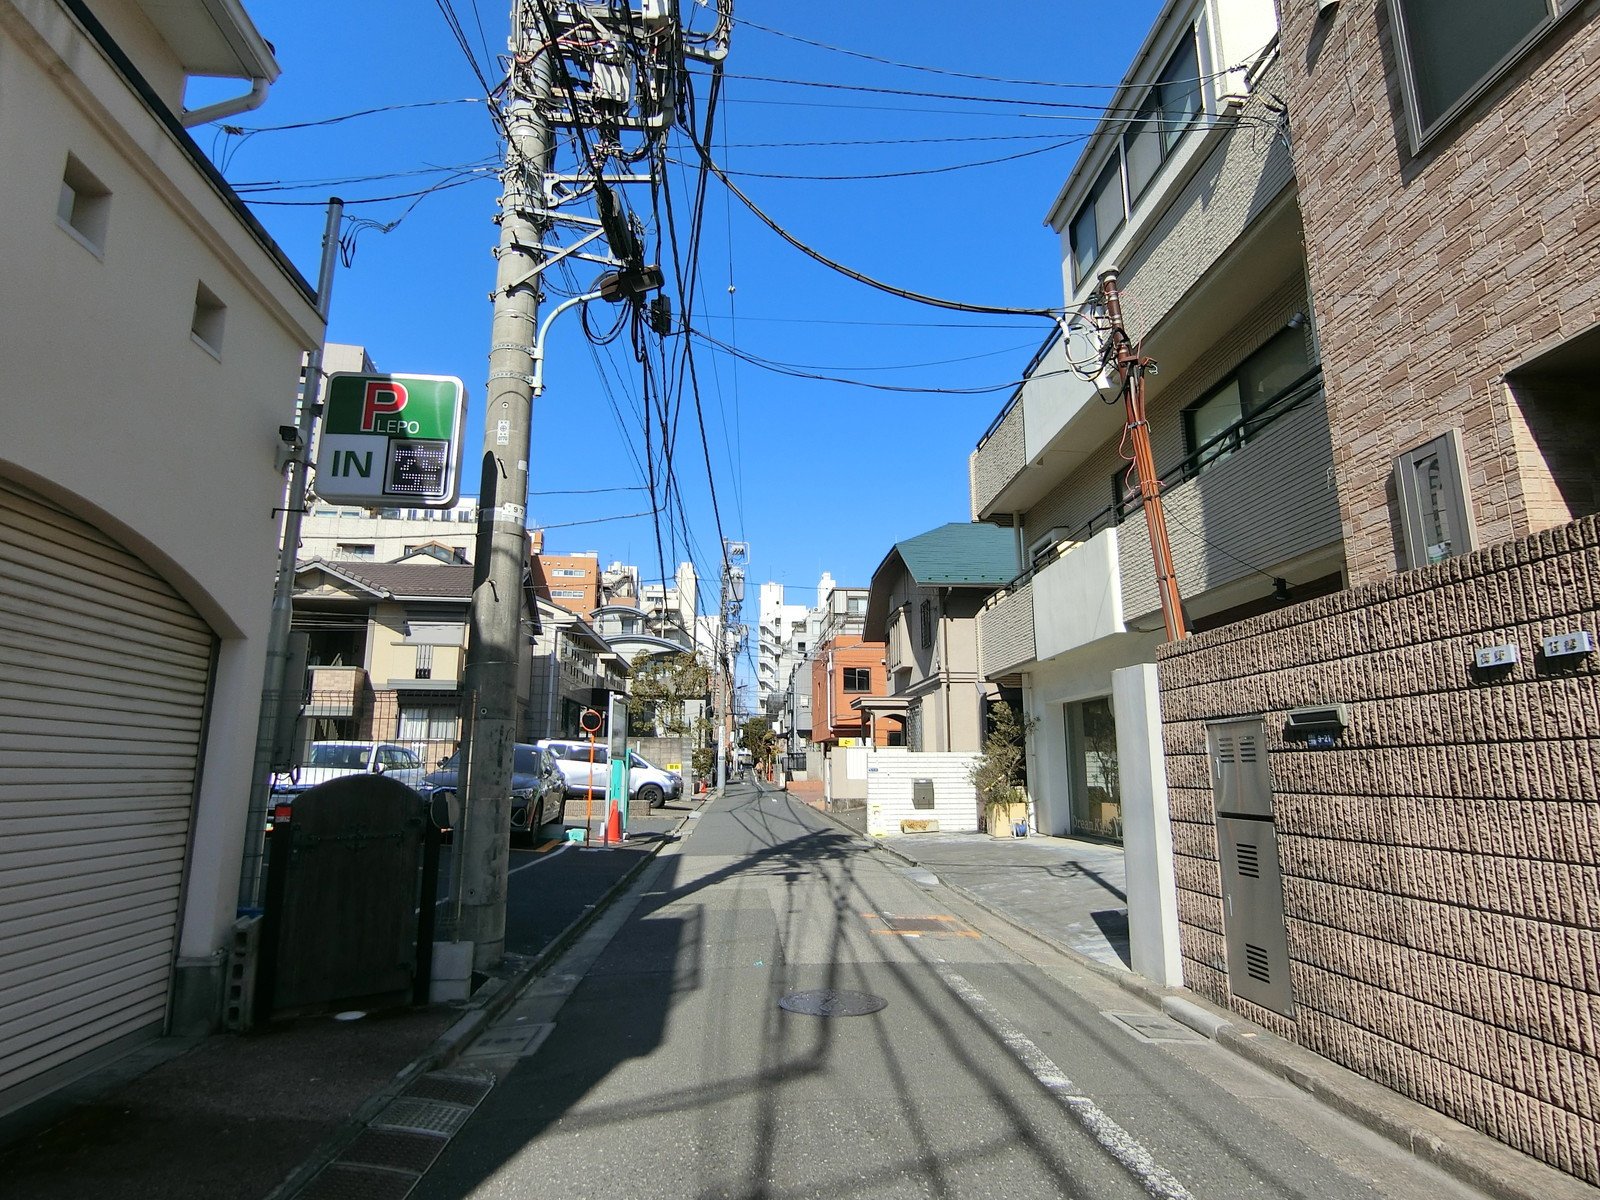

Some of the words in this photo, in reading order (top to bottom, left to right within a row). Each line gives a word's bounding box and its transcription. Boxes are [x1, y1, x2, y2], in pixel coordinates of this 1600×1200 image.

[360, 380, 409, 432] P
[376, 419, 420, 434] LEPO
[332, 450, 374, 478] IN
[392, 445, 445, 492] 空
[1073, 815, 1094, 830] Dream
